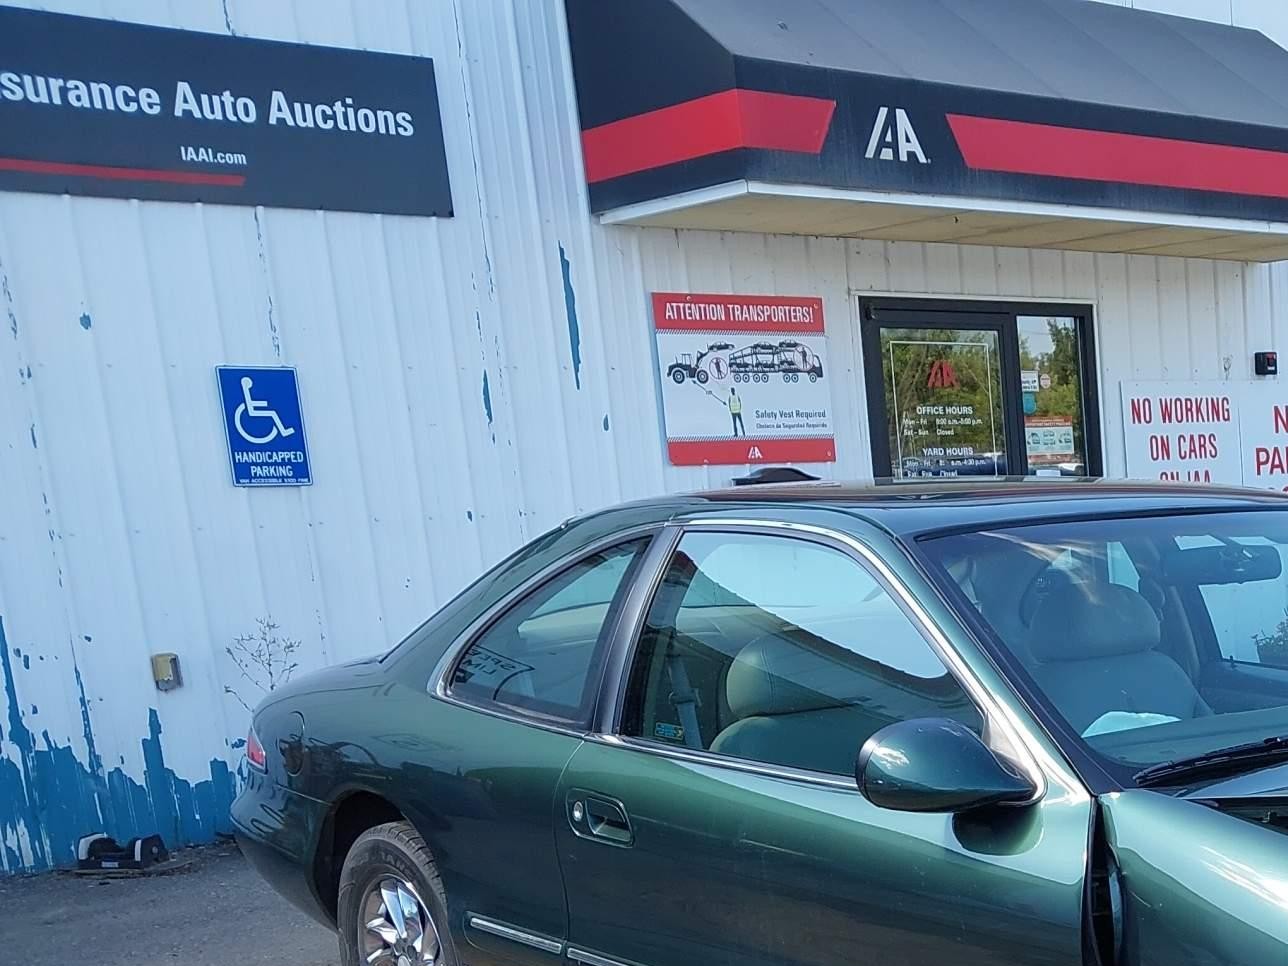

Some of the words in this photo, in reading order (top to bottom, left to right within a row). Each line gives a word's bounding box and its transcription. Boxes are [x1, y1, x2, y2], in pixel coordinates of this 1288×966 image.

[174, 81, 256, 123] Auto
[268, 90, 414, 136] Auctions
[180, 146, 247, 165] IAAI.com
[665, 302, 726, 321] ATTENTION
[727, 304, 814, 323] TRANSPORTERS!
[755, 410, 777, 420] Safety
[779, 410, 794, 418] Vest
[795, 409, 826, 420] Required
[916, 406, 944, 415] OFFICE
[946, 406, 973, 415] HOURS
[1131, 398, 1152, 424] NO
[1159, 397, 1231, 423] WORKING
[936, 428, 955, 436] Closed
[922, 448, 944, 456] YARD
[946, 447, 974, 456] HOURS
[1150, 435, 1170, 461] ON
[1177, 433, 1218, 460] CARS
[234, 451, 304, 463] HANDICAPPED
[250, 465, 293, 477] PARKING
